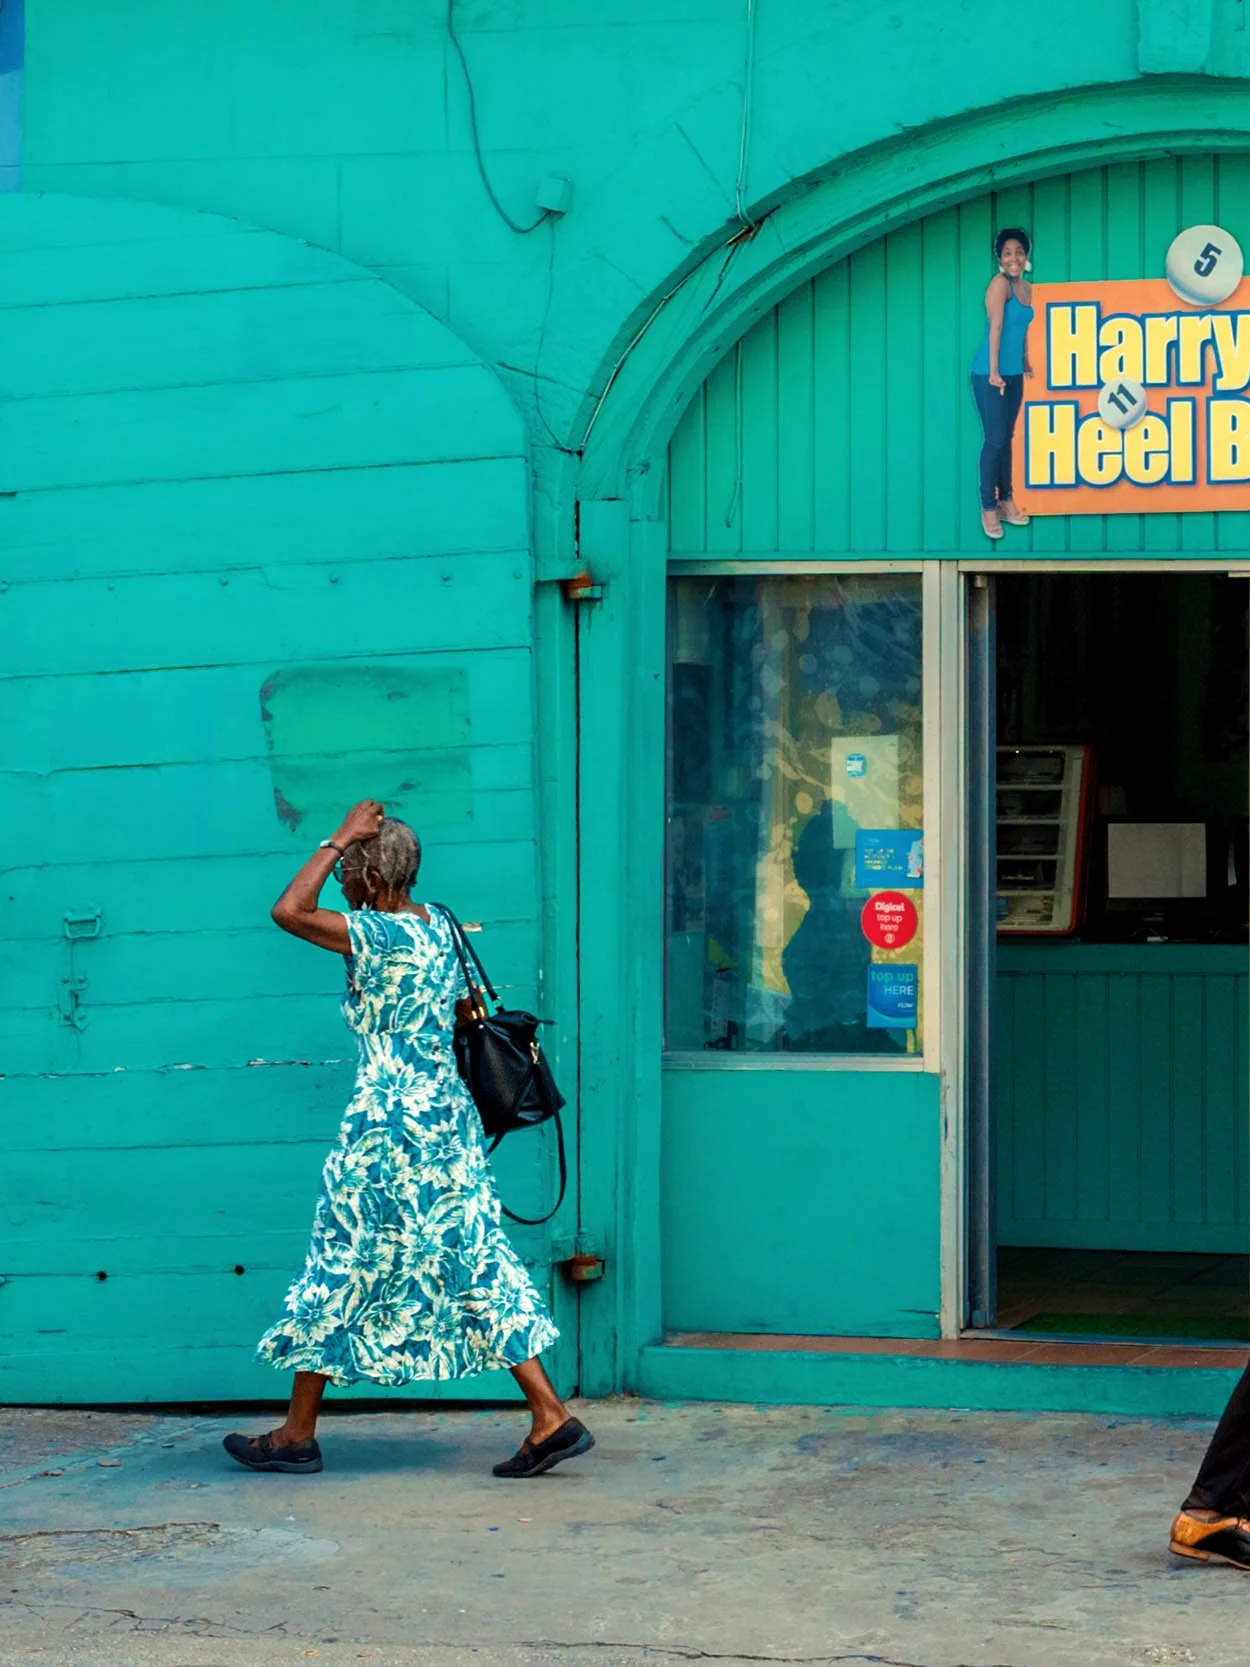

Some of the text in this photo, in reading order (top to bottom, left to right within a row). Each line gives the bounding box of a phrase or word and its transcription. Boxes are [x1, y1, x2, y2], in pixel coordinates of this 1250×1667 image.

[1193, 242, 1223, 278] 5
[1107, 384, 1138, 415] 11
[1026, 398, 1195, 487] Heel
[875, 901, 905, 913] Digicel
[877, 913, 903, 923] top up
[880, 923, 899, 931] here
[871, 971, 914, 983] top up
[884, 985, 914, 996] HERE
